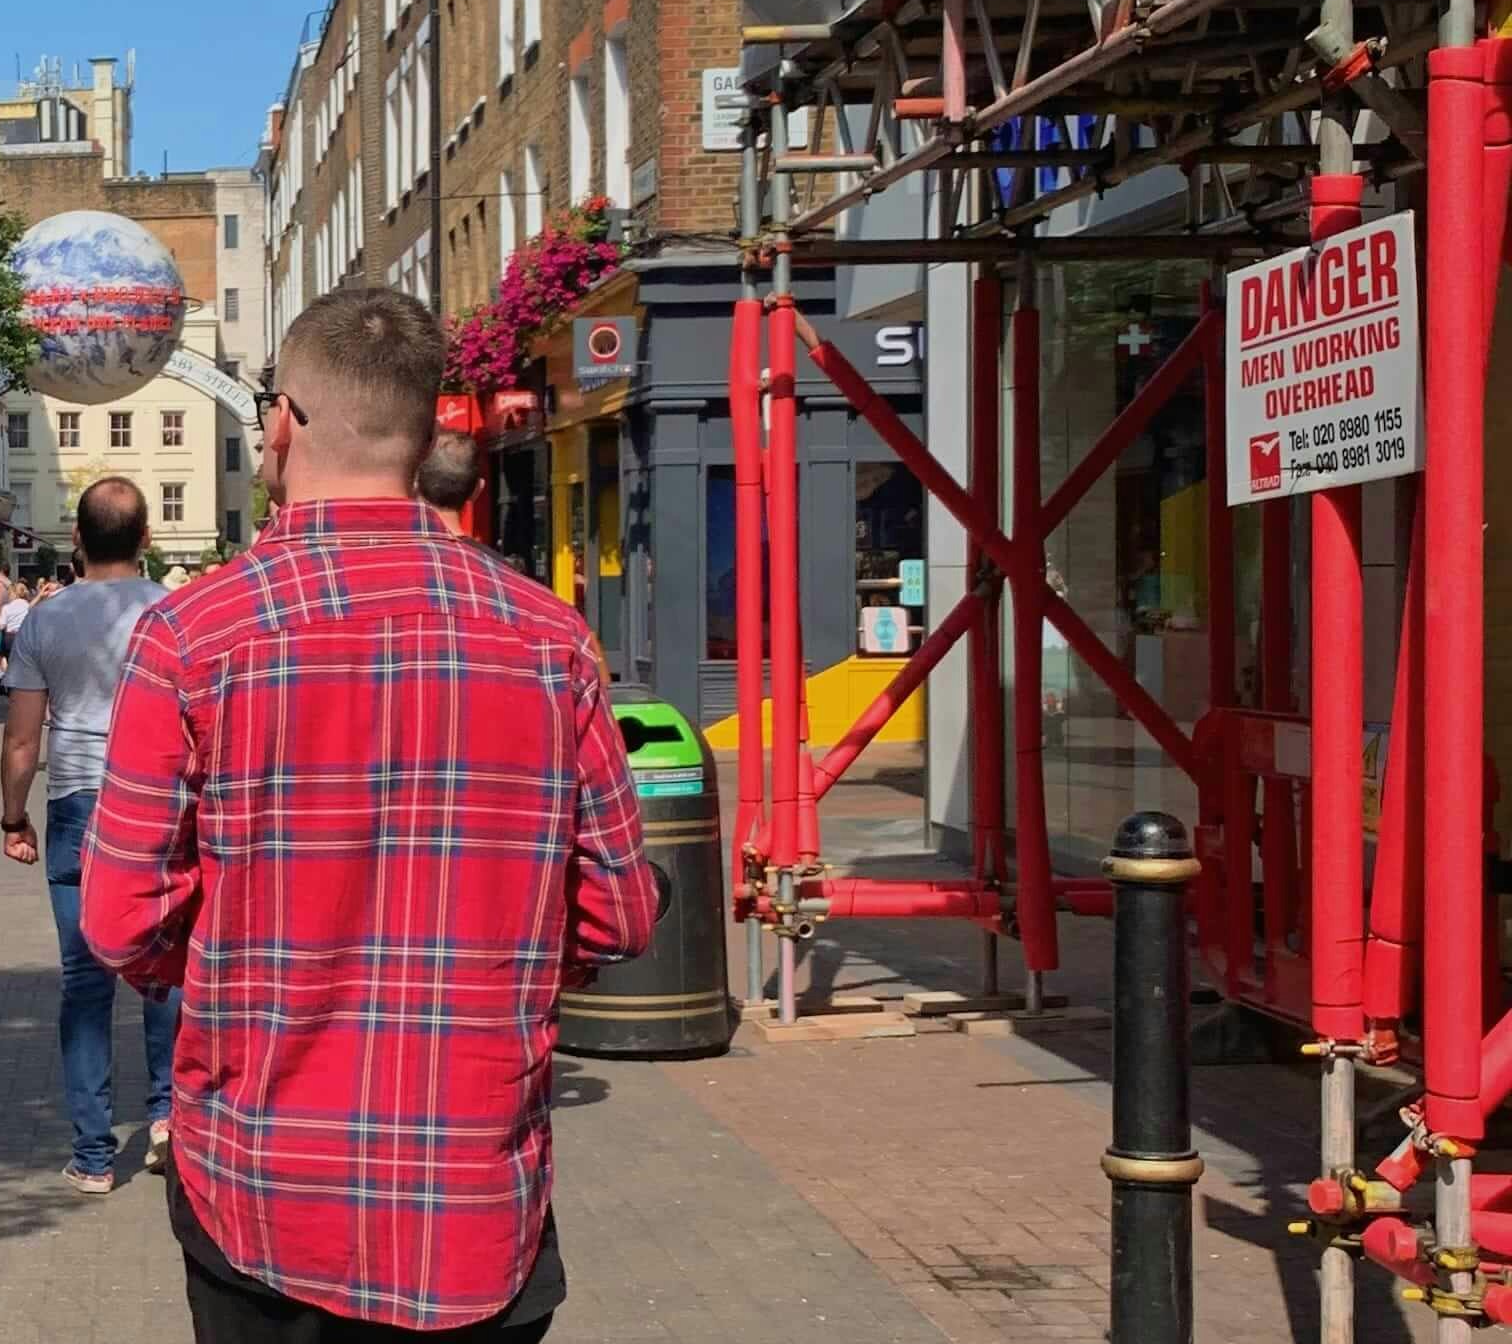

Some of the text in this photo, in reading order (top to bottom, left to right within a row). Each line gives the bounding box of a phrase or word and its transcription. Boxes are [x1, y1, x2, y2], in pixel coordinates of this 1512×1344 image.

[1241, 230, 1398, 342] DANGER
[1241, 317, 1400, 388] MEN WORKING
[1266, 365, 1375, 420] OVERHEAD
[1289, 407, 1403, 452] Tel: 020 8980 1155
[1315, 450, 1338, 475] 020
[1342, 444, 1371, 471] 8981
[1376, 436, 1405, 464] 3019
